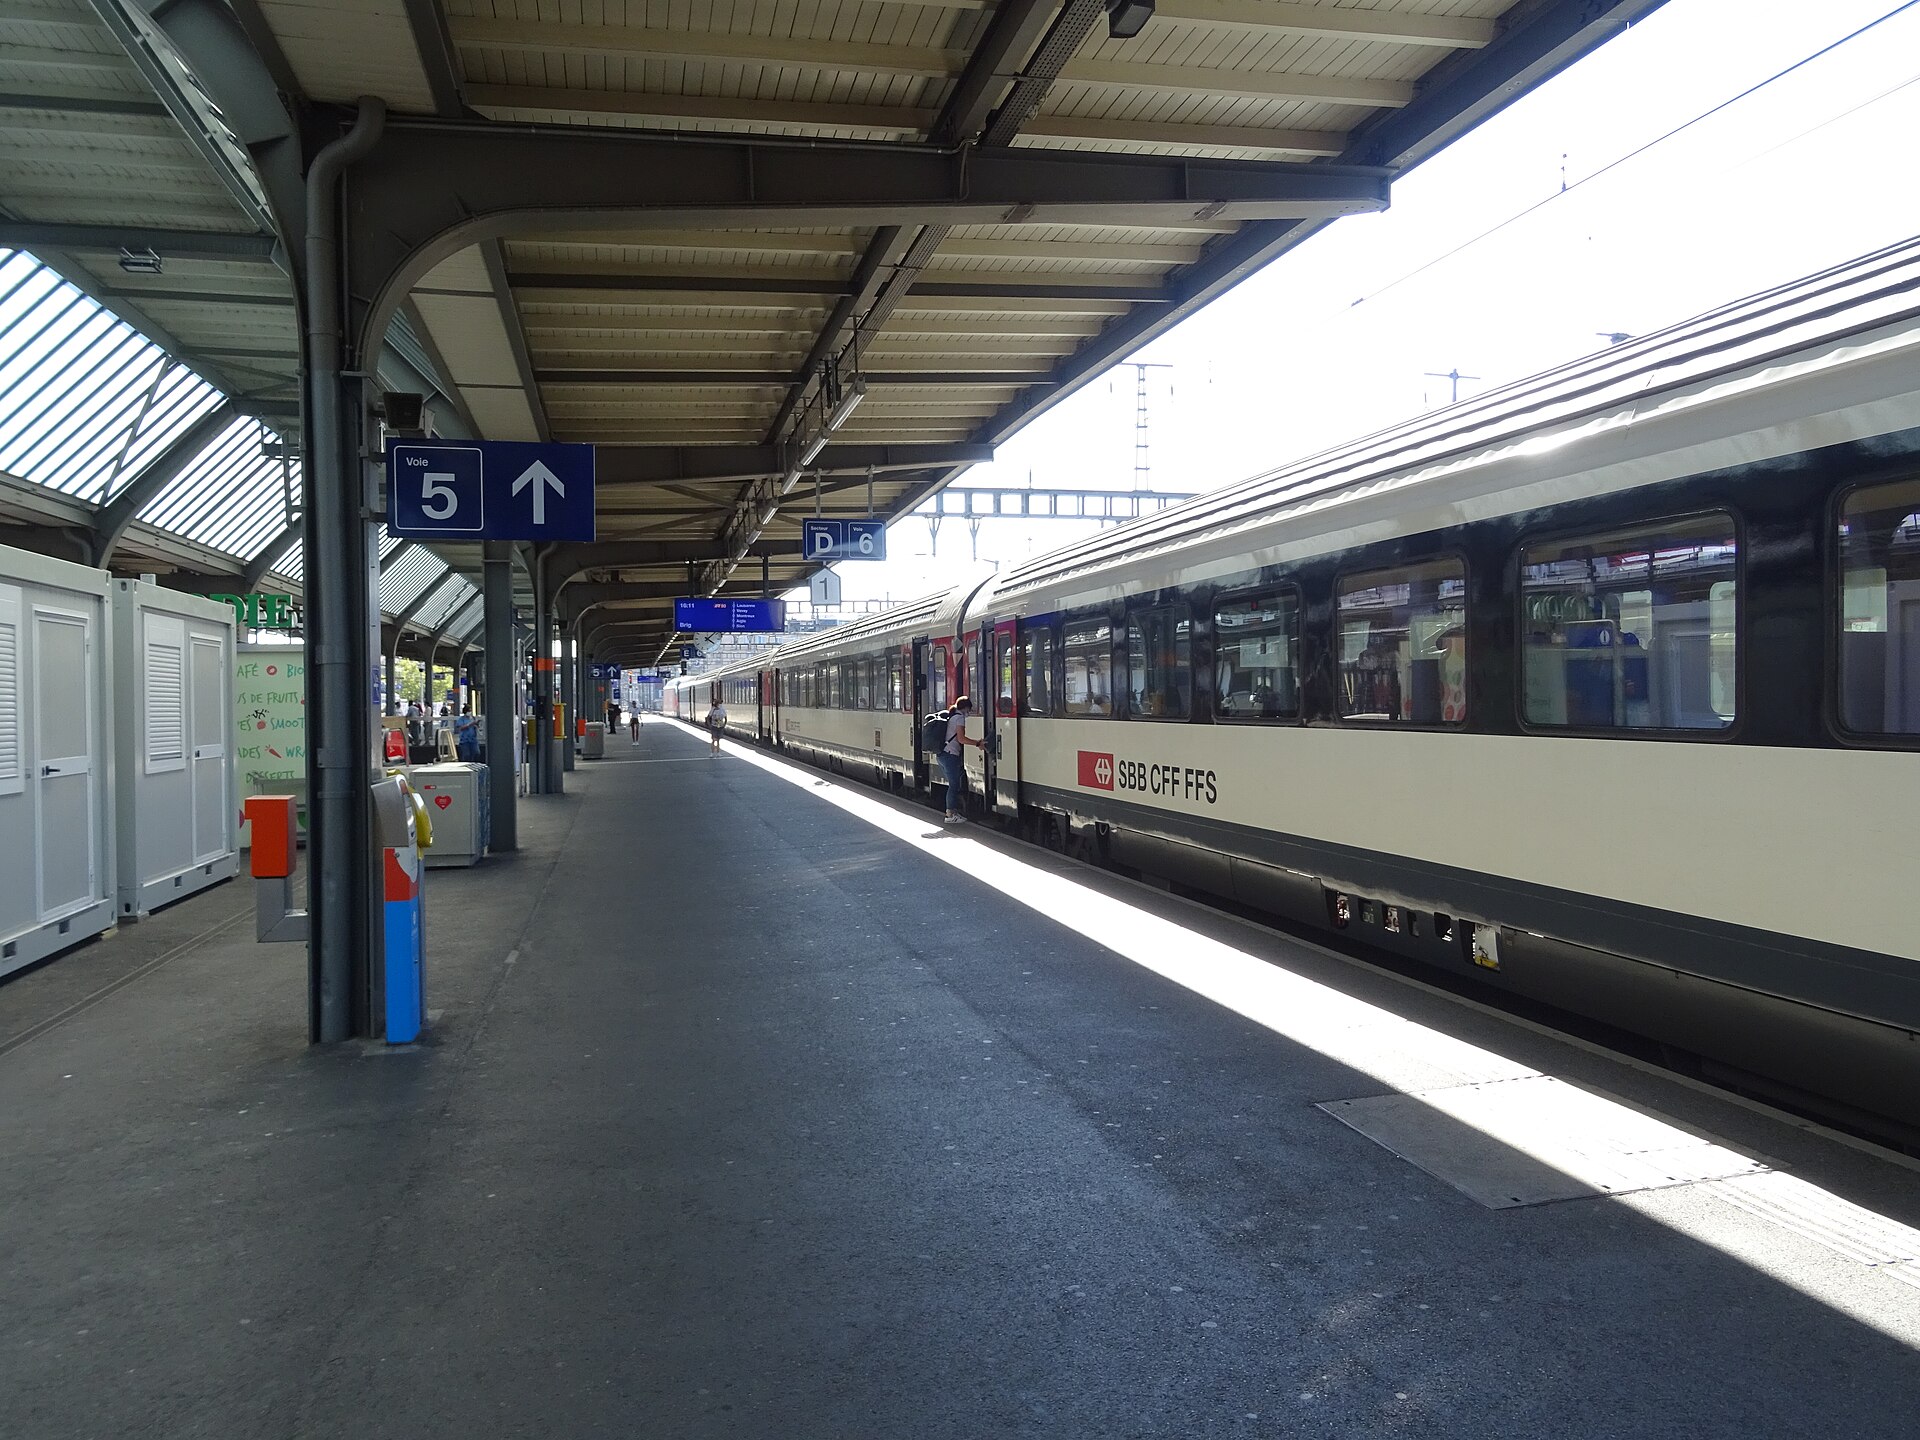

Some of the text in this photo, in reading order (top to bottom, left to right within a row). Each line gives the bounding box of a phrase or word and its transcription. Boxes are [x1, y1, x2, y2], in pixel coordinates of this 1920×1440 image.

[406, 457, 429, 467] Voie
[421, 472, 458, 520] 5
[815, 532, 833, 553] D
[859, 533, 874, 554] 6
[819, 577, 828, 600] 1
[192, 593, 293, 628] DIE
[928, 642, 933, 661] 2
[593, 668, 600, 677] 5
[250, 693, 262, 704] DE
[267, 691, 298, 705] FRUITS
[237, 719, 251, 731] ES
[1118, 759, 1217, 804] SBB CFF FFS
